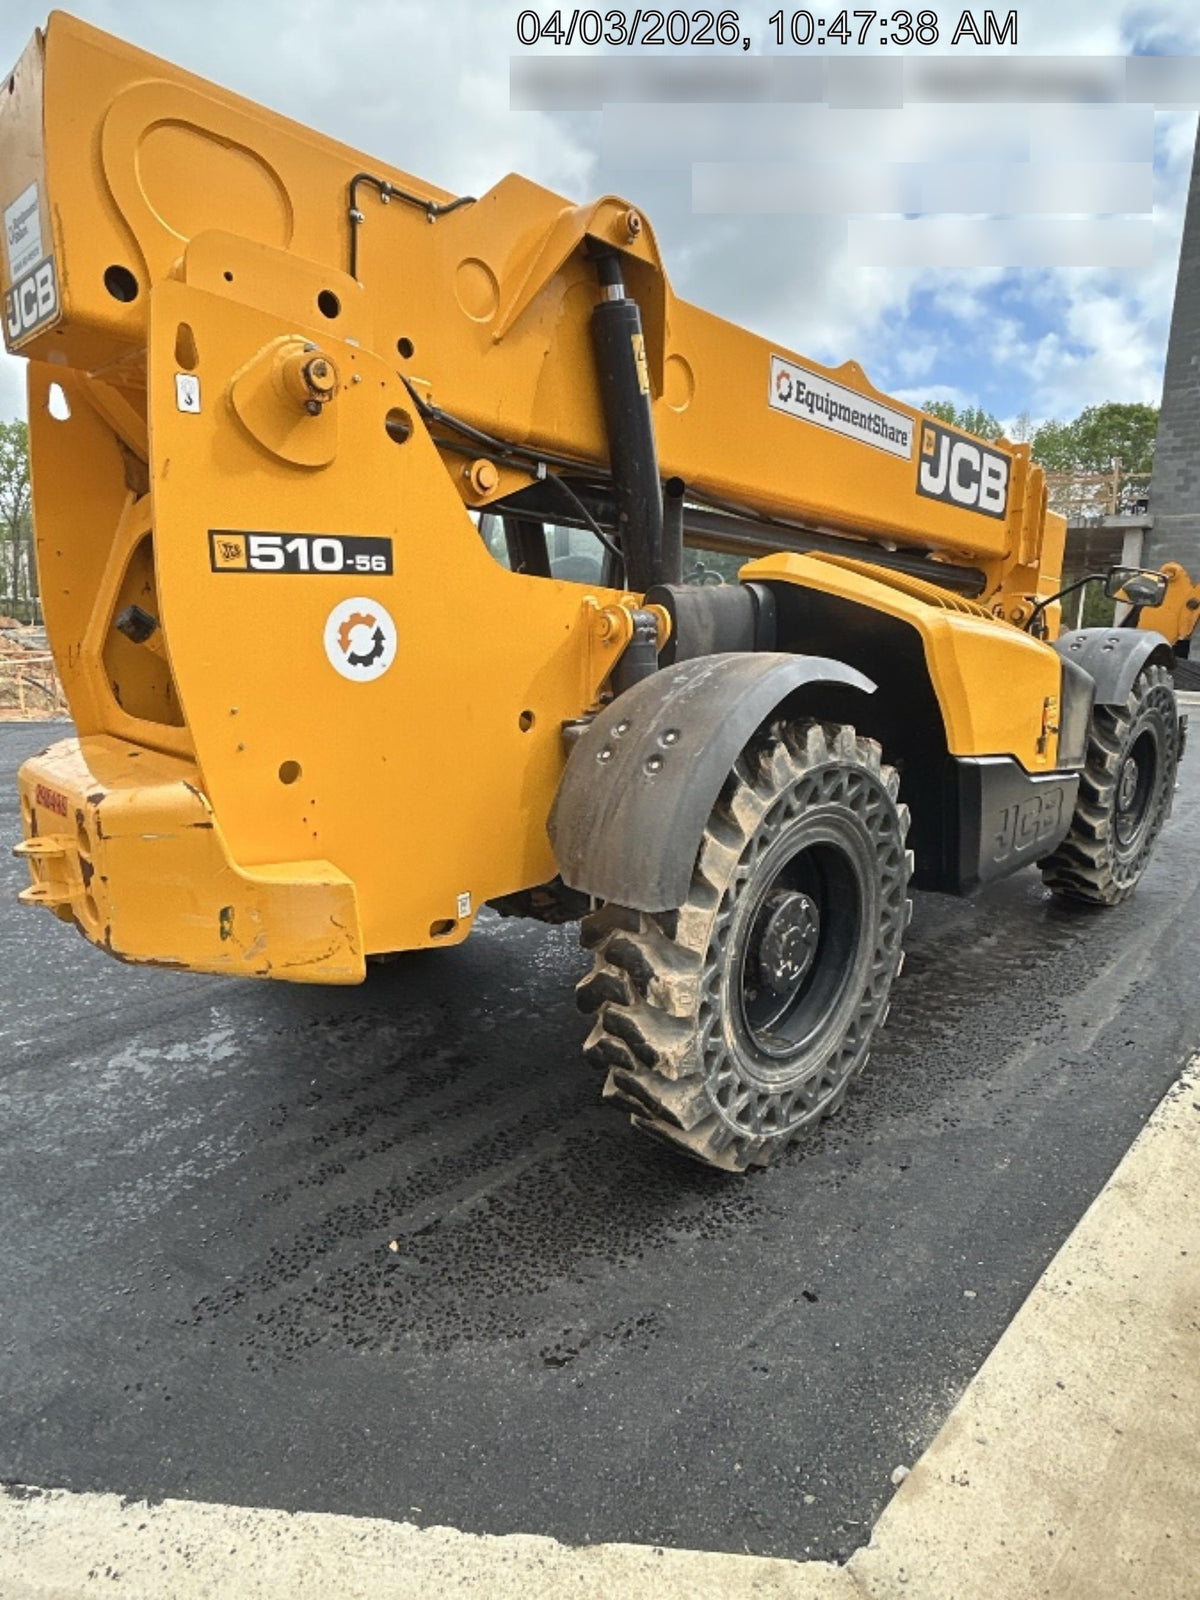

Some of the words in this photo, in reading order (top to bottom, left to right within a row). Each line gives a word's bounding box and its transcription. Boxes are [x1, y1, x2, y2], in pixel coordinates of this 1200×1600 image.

[8, 263, 55, 338] JCB
[795, 380, 908, 447] EquipmentShare
[920, 434, 1008, 513] JCB
[249, 535, 387, 571] 510-56
